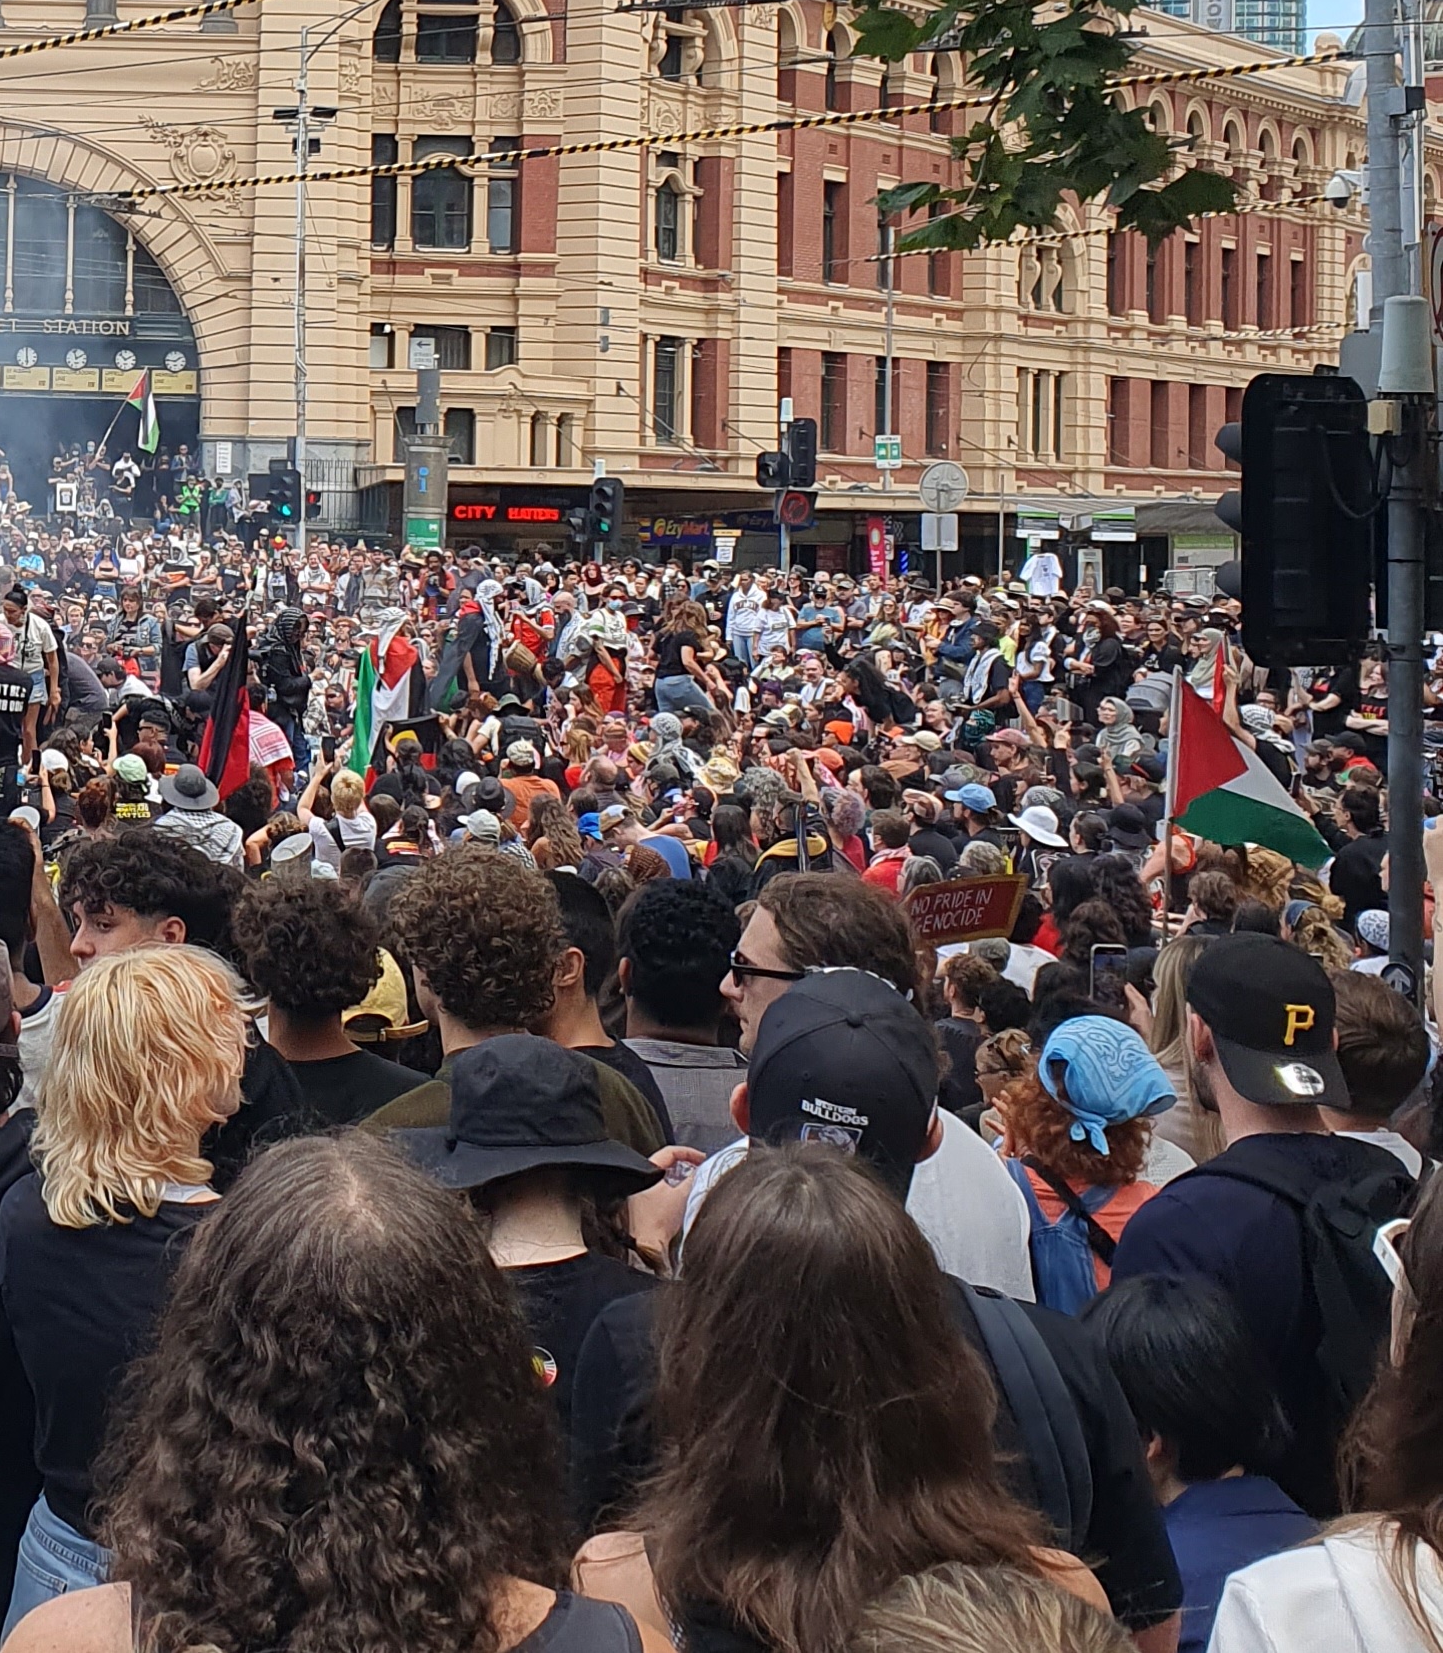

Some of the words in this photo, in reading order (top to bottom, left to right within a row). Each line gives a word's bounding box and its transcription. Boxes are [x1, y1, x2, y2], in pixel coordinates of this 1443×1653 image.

[43, 320, 130, 336] STATION
[454, 506, 496, 519] CITY
[911, 896, 931, 916] NO
[933, 889, 974, 912] PRIDE
[975, 887, 993, 905] IN
[915, 906, 985, 934] GENOCIDE
[1284, 1004, 1315, 1046] P
[801, 1099, 869, 1126] BULLDOGS
[815, 1097, 857, 1115] WESTERN
